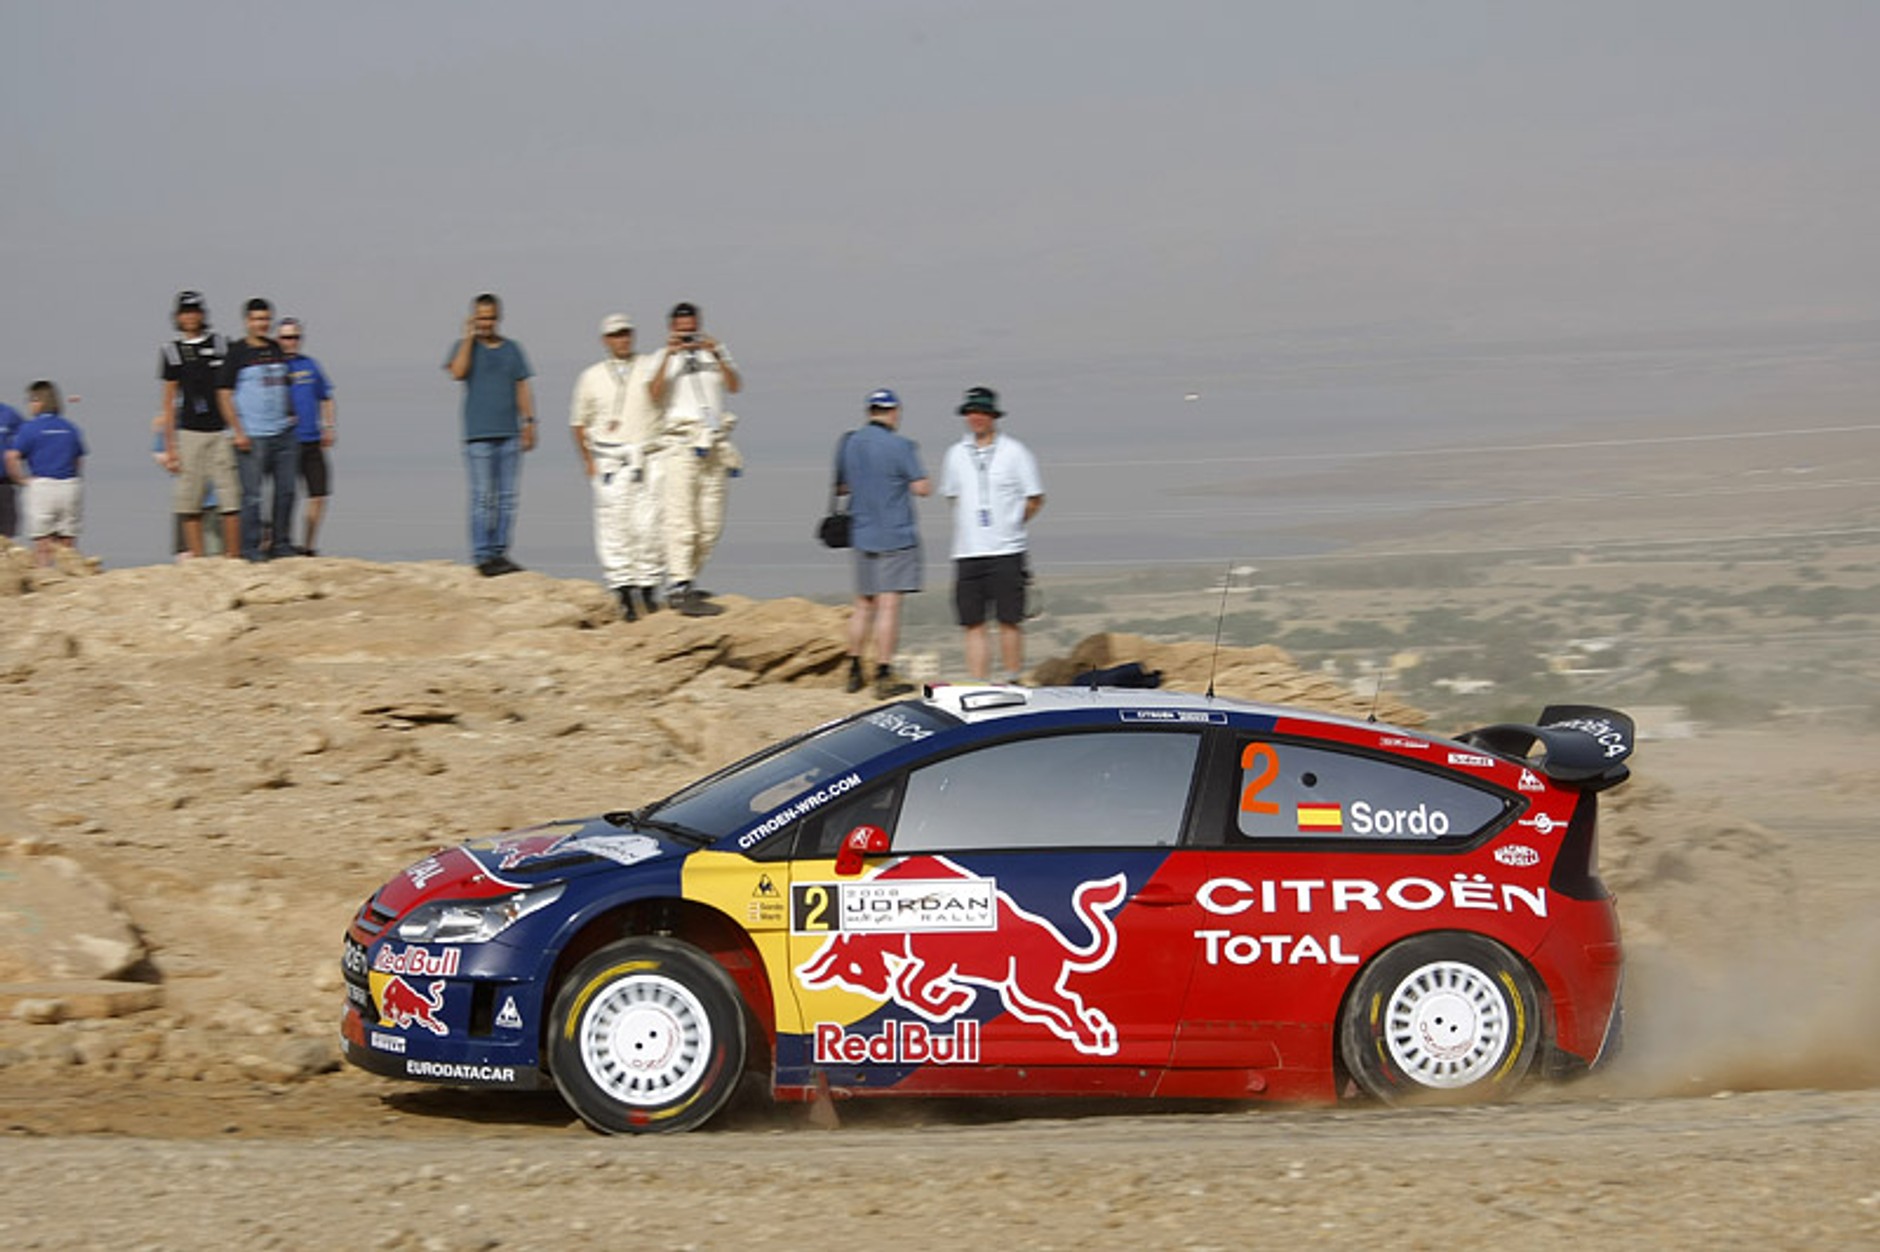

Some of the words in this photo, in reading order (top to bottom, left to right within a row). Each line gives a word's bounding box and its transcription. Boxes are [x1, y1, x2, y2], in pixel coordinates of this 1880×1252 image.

[1241, 741, 1280, 815] 2
[1350, 800, 1449, 836] Sordo
[804, 885, 830, 931] 2
[846, 896, 989, 913] JORDAN
[1194, 873, 1548, 918] CITROËN
[920, 913, 988, 922] RALLY
[815, 1020, 896, 1062] Red
[901, 1020, 979, 1062] Bull
[406, 1059, 515, 1082] EURODATACAR
